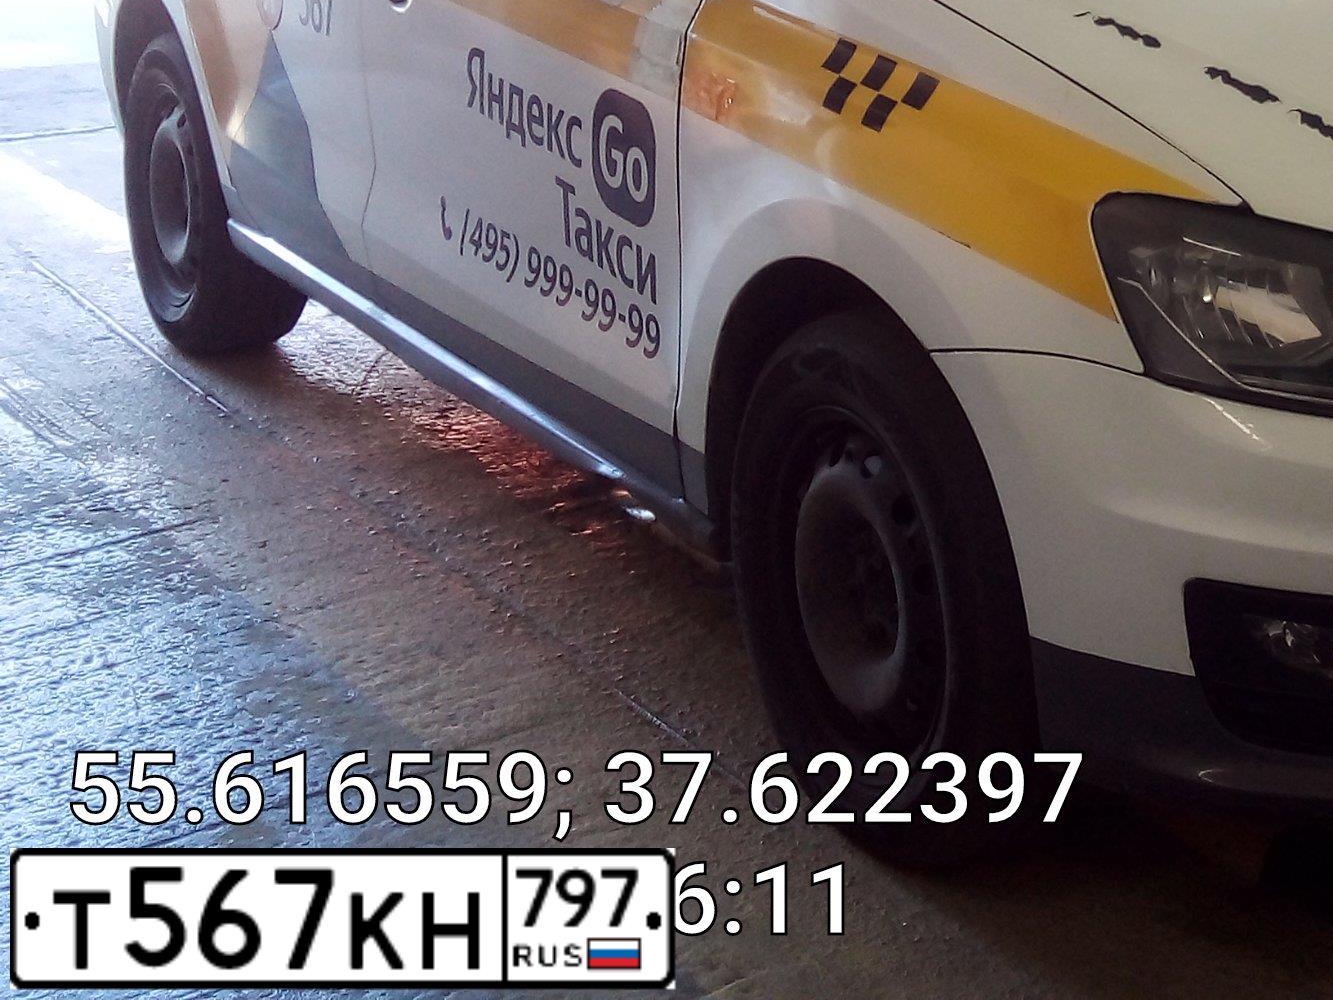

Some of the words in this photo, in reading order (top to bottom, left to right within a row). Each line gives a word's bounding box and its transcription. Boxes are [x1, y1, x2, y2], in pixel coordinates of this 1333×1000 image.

[466, 47, 583, 168] Яндекс
[599, 113, 649, 204] Go
[460, 208, 520, 283] (495)
[524, 246, 661, 359] 999-99-99
[555, 176, 658, 304] Такси
